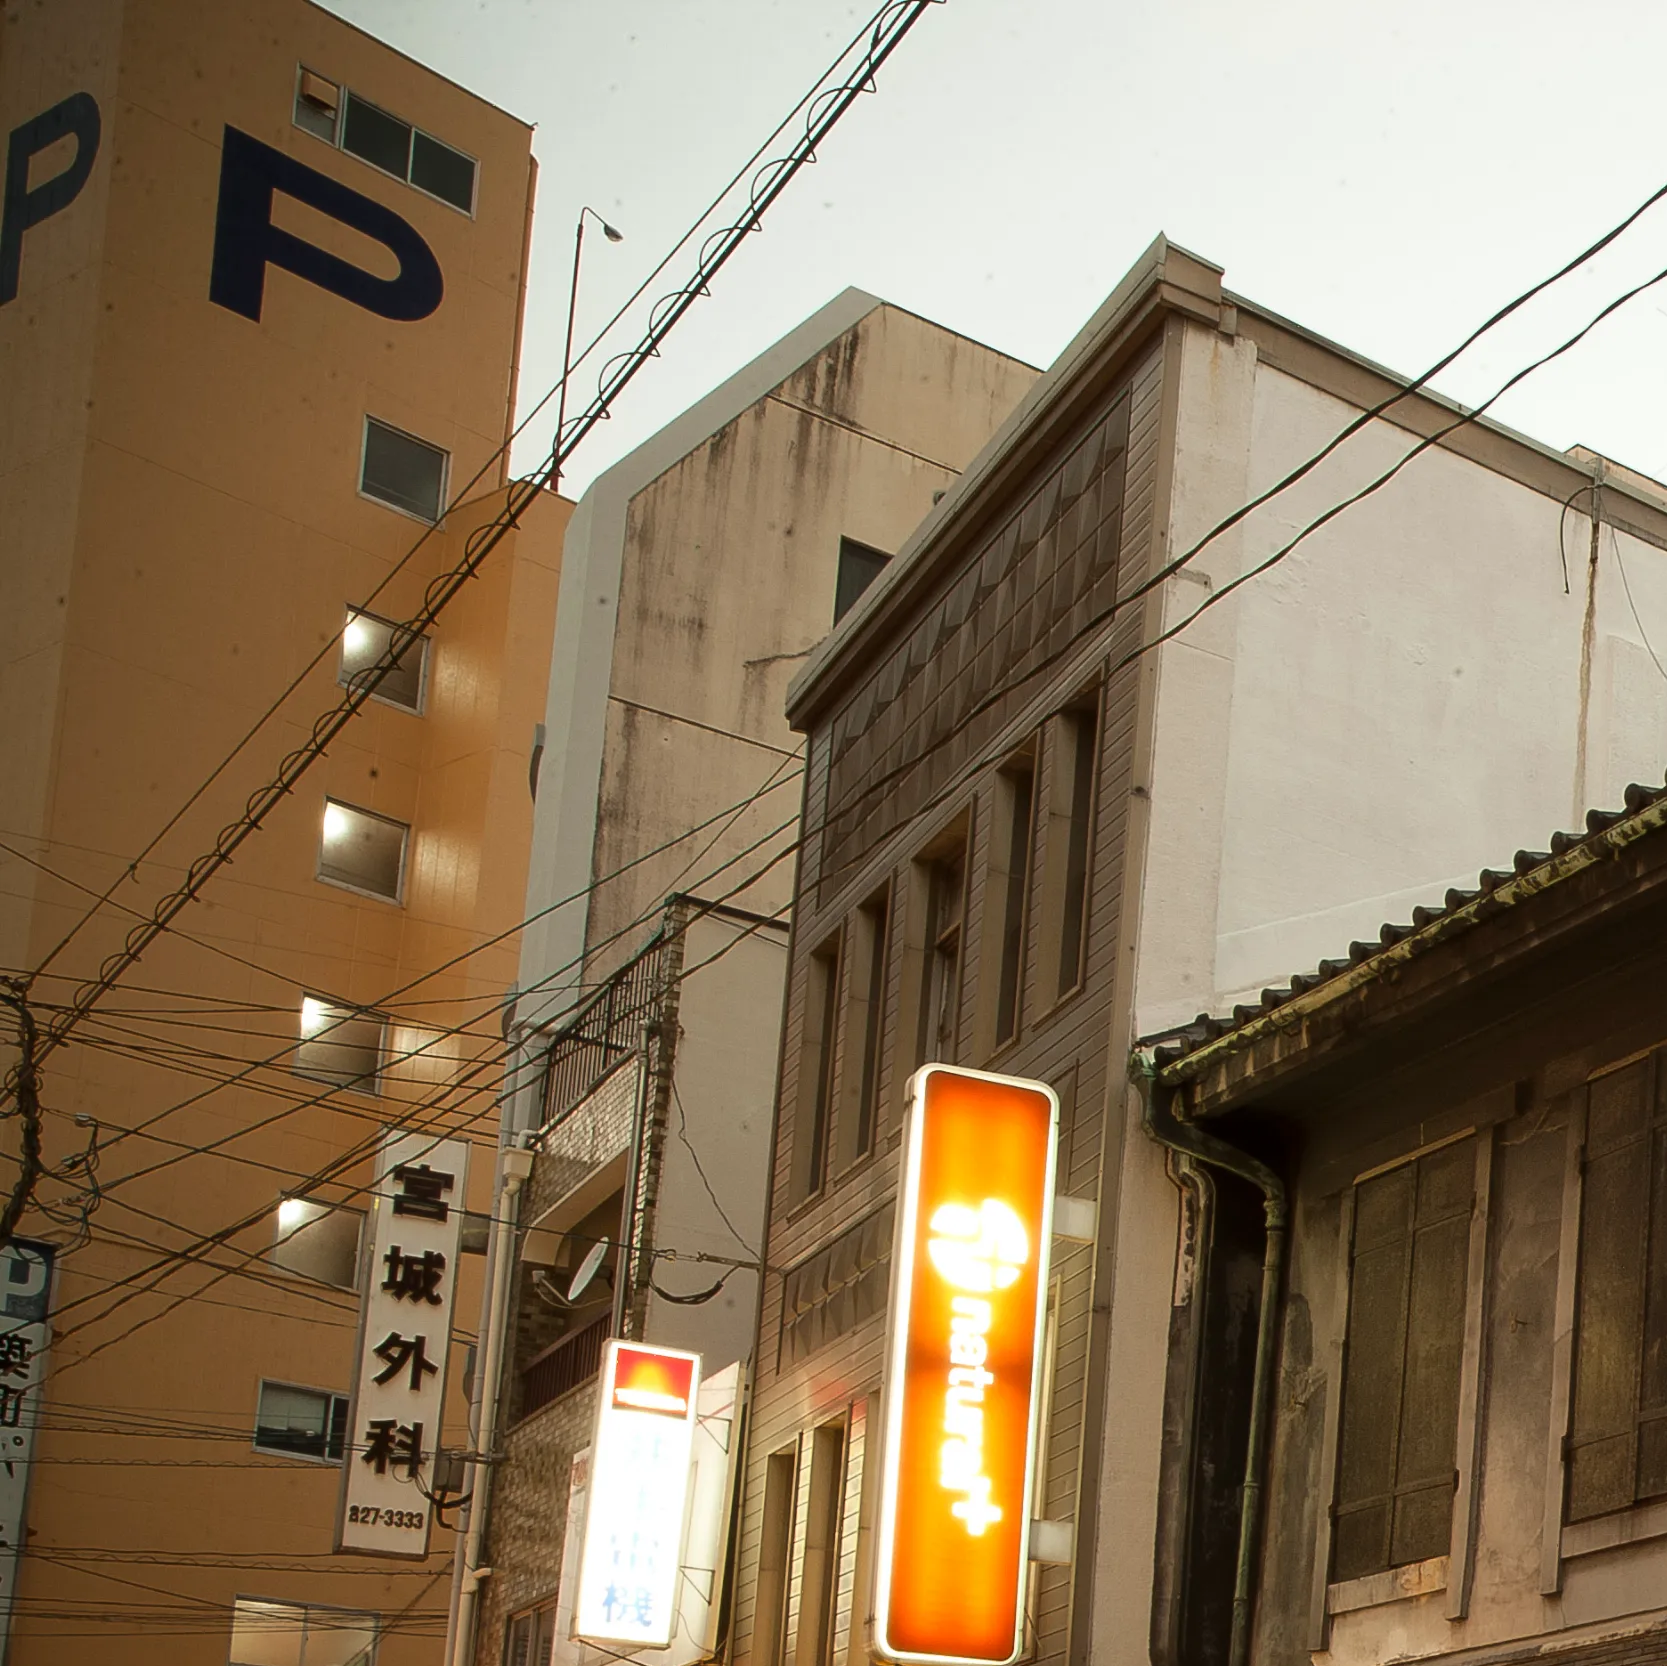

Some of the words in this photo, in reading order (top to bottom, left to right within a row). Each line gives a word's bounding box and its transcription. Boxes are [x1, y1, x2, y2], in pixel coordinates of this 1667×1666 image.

[209, 124, 444, 324] P
[361, 1163, 455, 1479] 宮城外科
